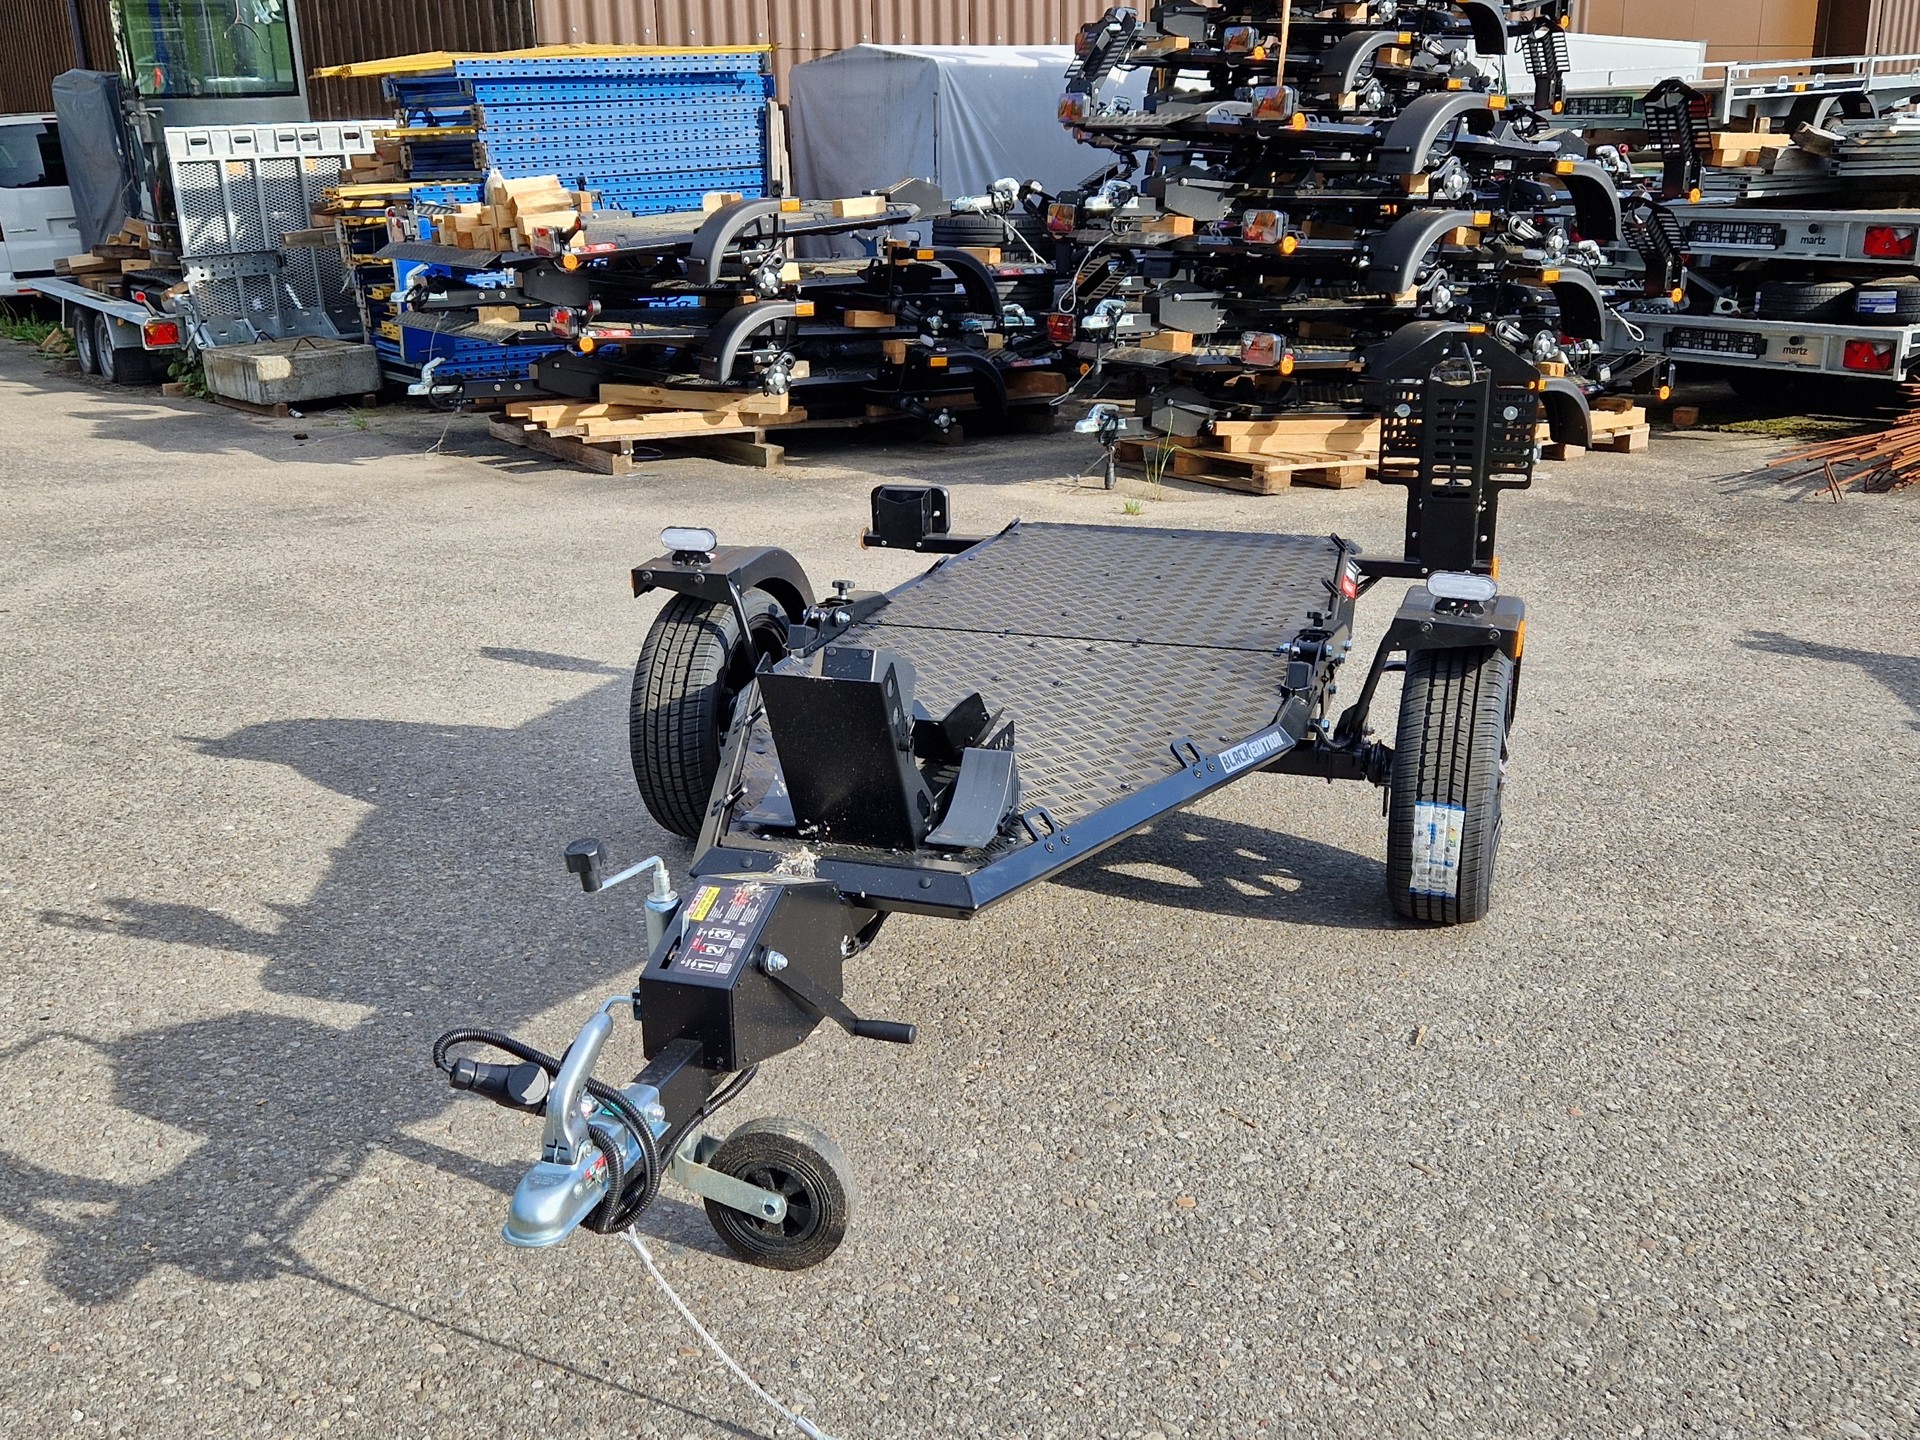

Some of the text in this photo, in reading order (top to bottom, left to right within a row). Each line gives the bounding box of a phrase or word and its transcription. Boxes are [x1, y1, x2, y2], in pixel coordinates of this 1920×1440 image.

[1800, 236, 1826, 245] martz
[1782, 346, 1808, 356] martz
[1221, 731, 1285, 770] BLACK EDITION
[714, 930, 732, 939] 3
[705, 945, 724, 954] 2
[697, 962, 714, 970] 1
